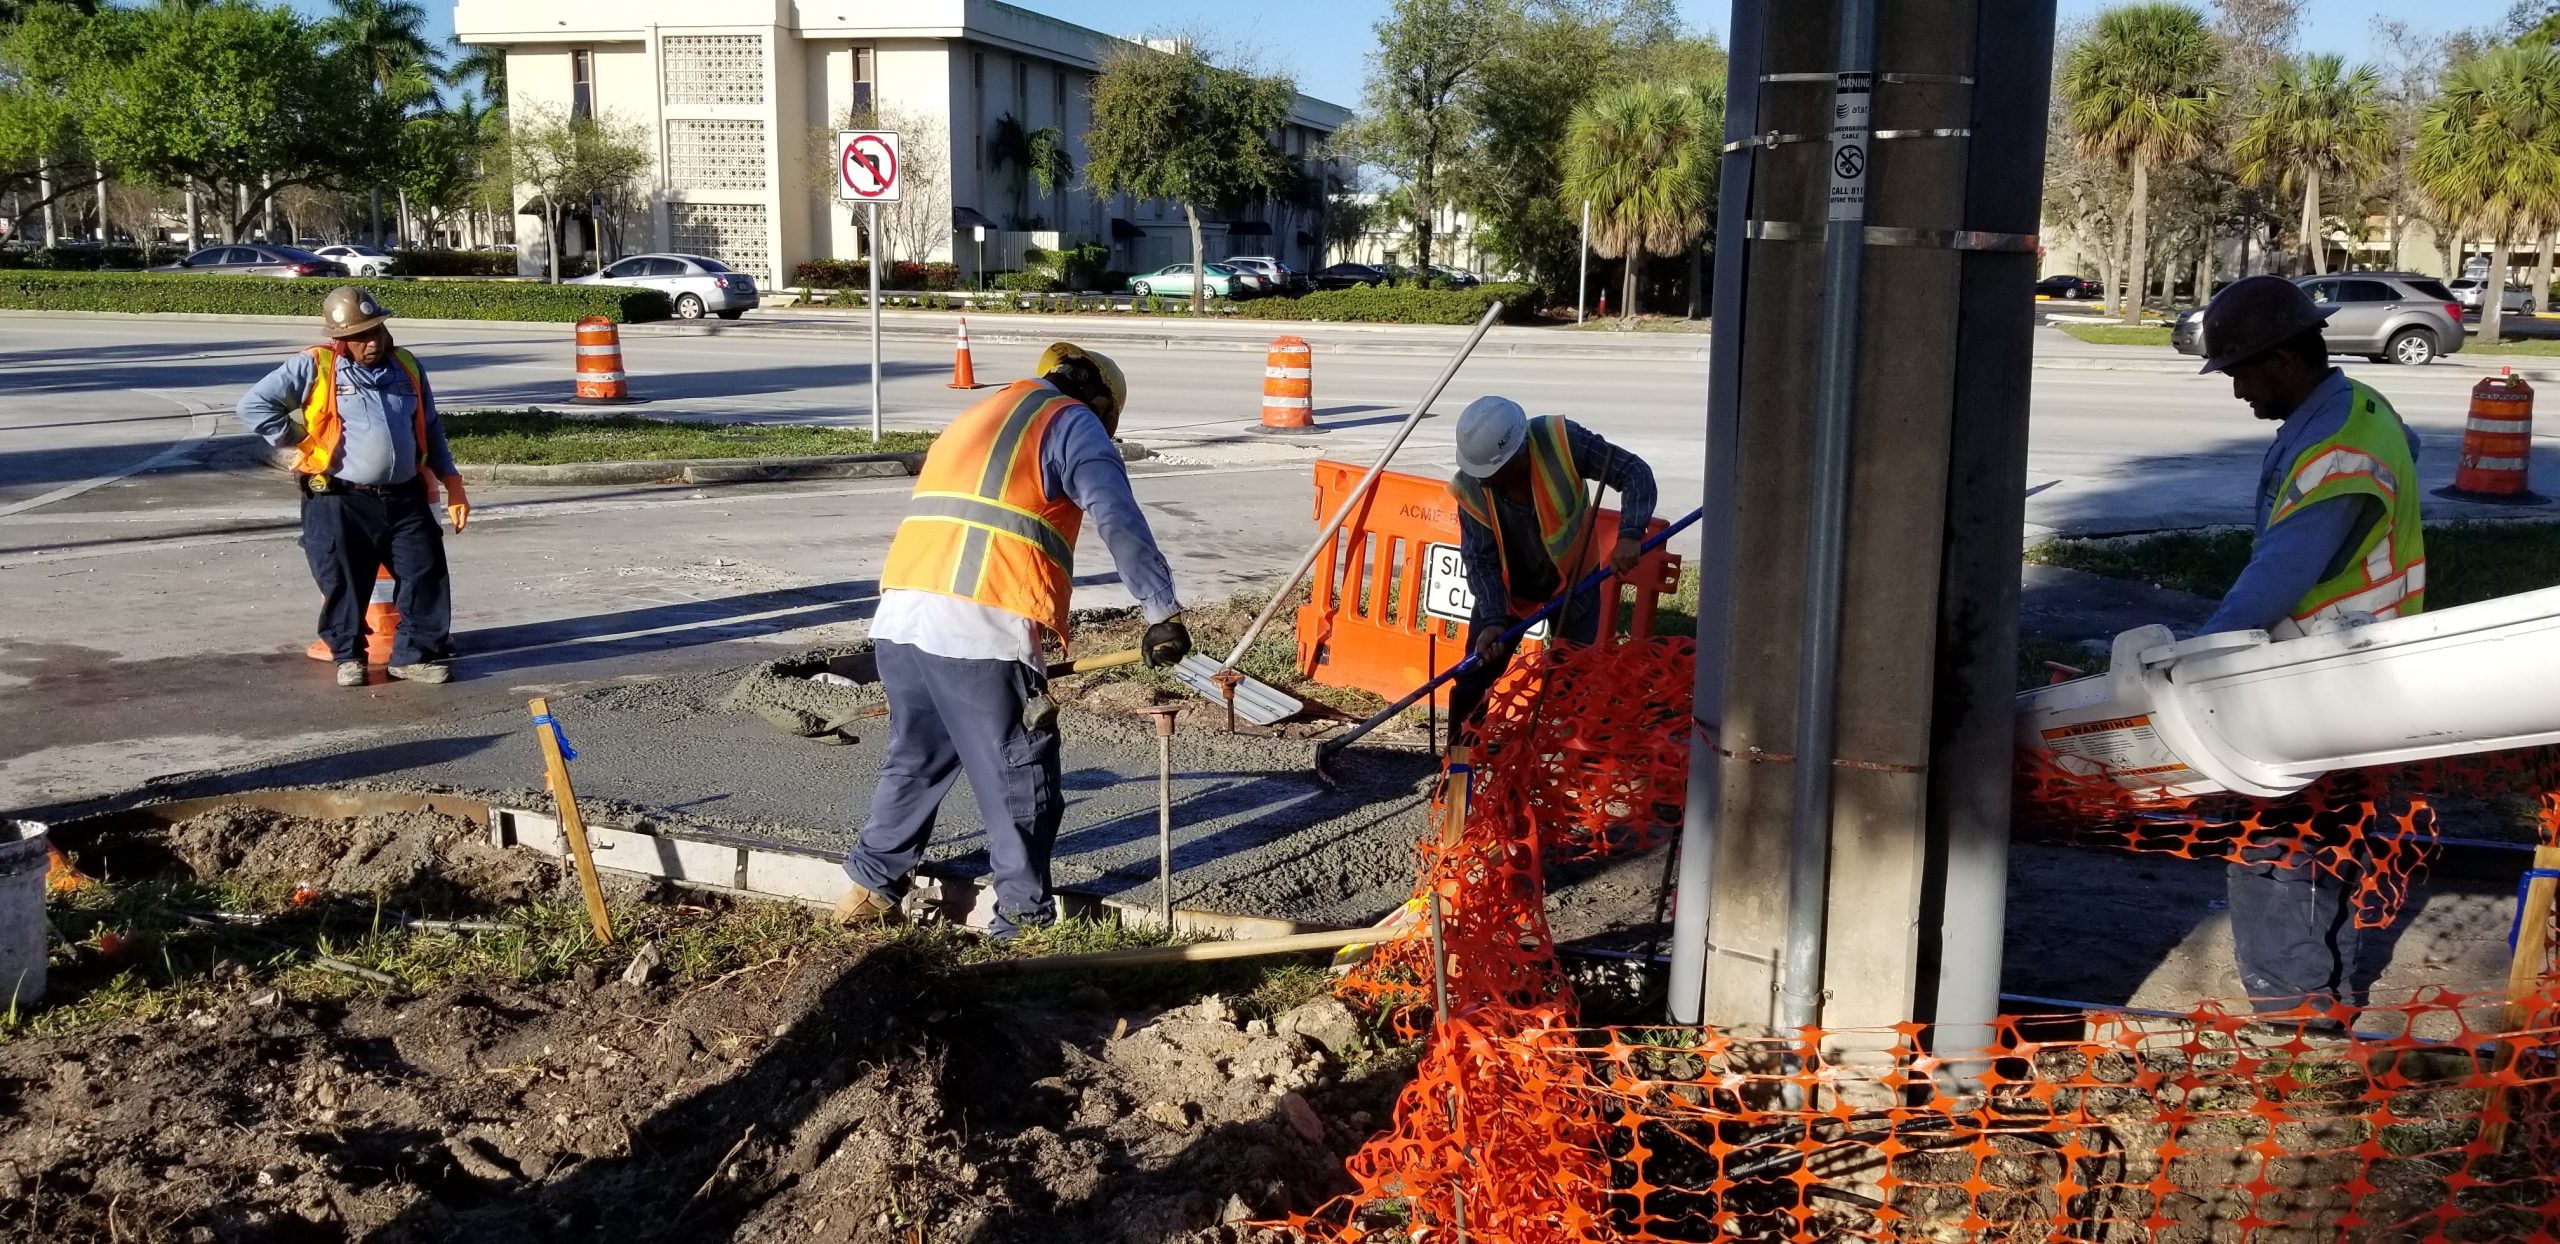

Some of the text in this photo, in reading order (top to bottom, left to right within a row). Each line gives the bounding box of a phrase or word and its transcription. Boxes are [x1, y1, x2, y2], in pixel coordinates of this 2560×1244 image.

[1832, 186, 1863, 195] CALL 811
[1400, 503, 1442, 523] ACME
[2071, 719, 2135, 736] WARNING
